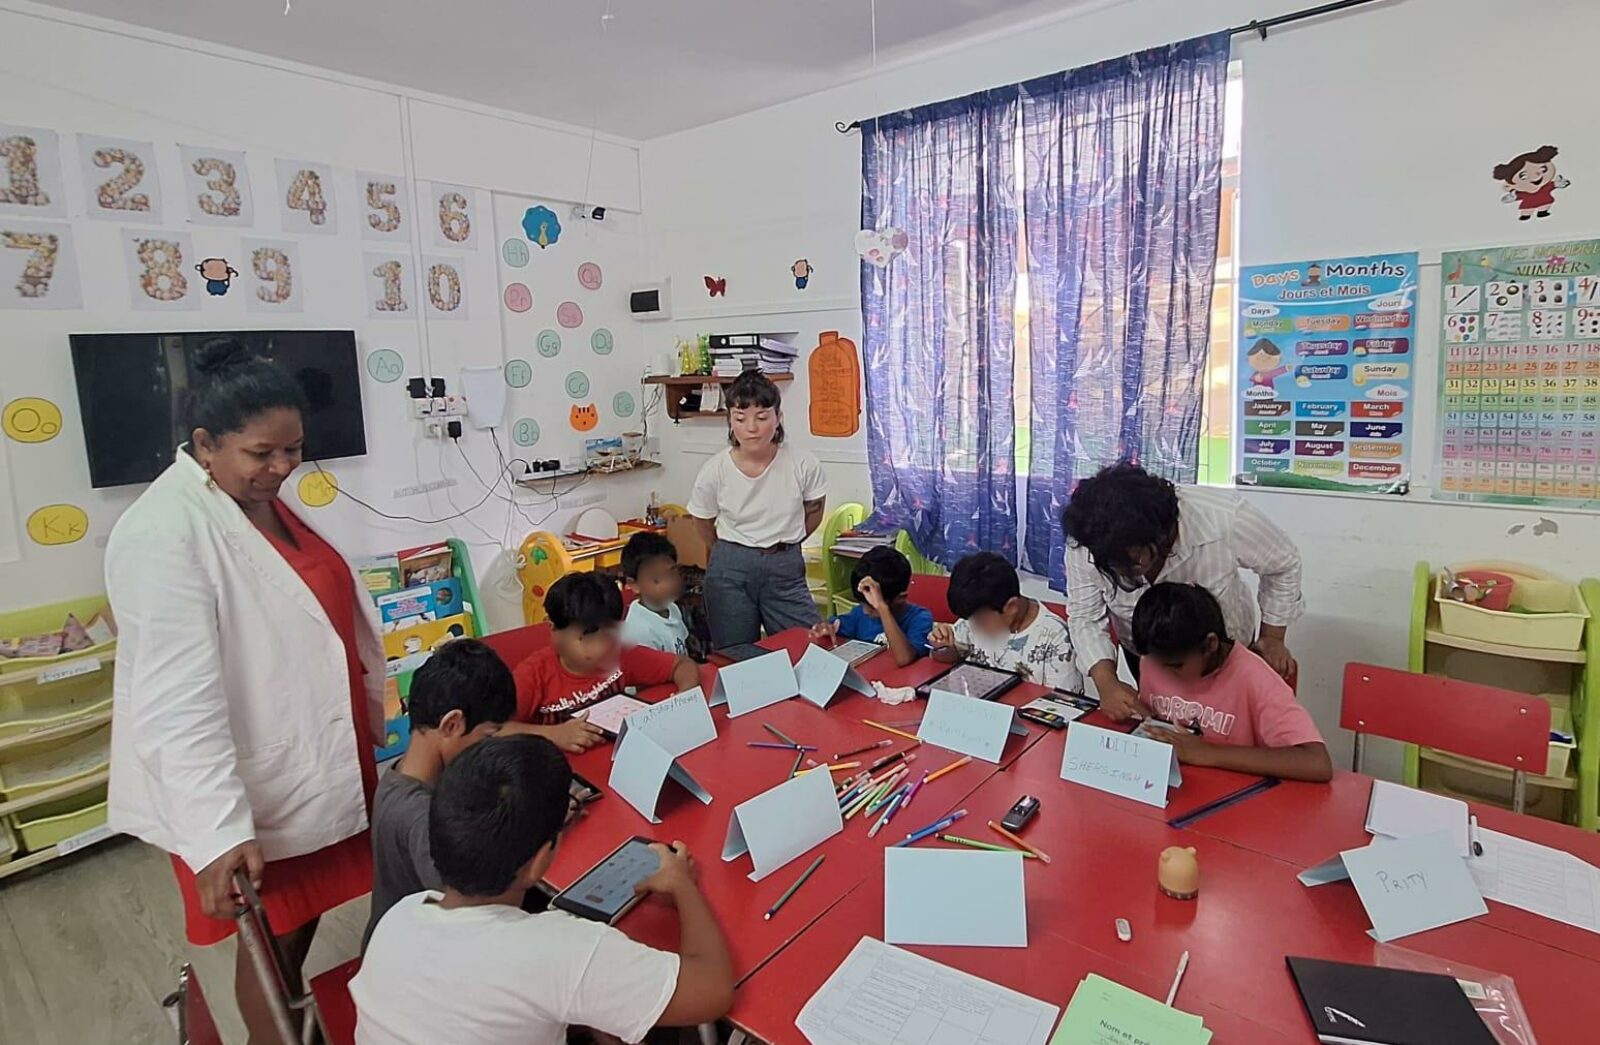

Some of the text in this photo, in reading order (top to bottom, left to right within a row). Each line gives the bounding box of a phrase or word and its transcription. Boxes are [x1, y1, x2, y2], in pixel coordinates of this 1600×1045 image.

[92, 148, 150, 211] 2
[193, 158, 241, 216] 3
[287, 170, 327, 225] 4
[367, 182, 400, 232] 5
[439, 192, 470, 242] 6
[0, 231, 58, 297] 7
[138, 239, 188, 300] 8
[252, 248, 292, 303] 9
[1251, 261, 1405, 288] Days Months
[1280, 284, 1370, 300] Jours et Mois
[1451, 278, 1591, 298] 1 2 3 4
[1251, 306, 1271, 315] Days
[1253, 318, 1283, 328] Monday
[1306, 317, 1341, 326] Tuesday
[1448, 309, 1588, 328] 6 7 8 9
[540, 335, 558, 356] Gg
[1450, 344, 1600, 356] 11 12 13 14 15 16 17 18
[1364, 366, 1397, 374] Sunday
[1449, 363, 1459, 371] 21
[1468, 363, 1479, 371] 22
[1486, 363, 1497, 371] 23
[1545, 362, 1557, 370] 26
[1565, 362, 1578, 370] 27
[1585, 361, 1599, 369] 28
[1448, 379, 1598, 388] 31 32 33 34 35 36 37 38
[1246, 388, 1274, 397] Months
[1377, 388, 1398, 397] Mois
[1252, 403, 1390, 412] January February March
[11, 408, 58, 434] Oo
[1583, 413, 1595, 421] 58
[1258, 421, 1386, 432] April May June
[520, 423, 539, 443] Bb
[1258, 440, 1274, 449] July
[1305, 442, 1333, 450] August
[1251, 459, 1281, 467] October
[1353, 464, 1396, 472] December
[1376, 870, 1428, 894] PRITY
[1100, 1019, 1120, 1034] Nom
[1122, 1032, 1132, 1041] et
